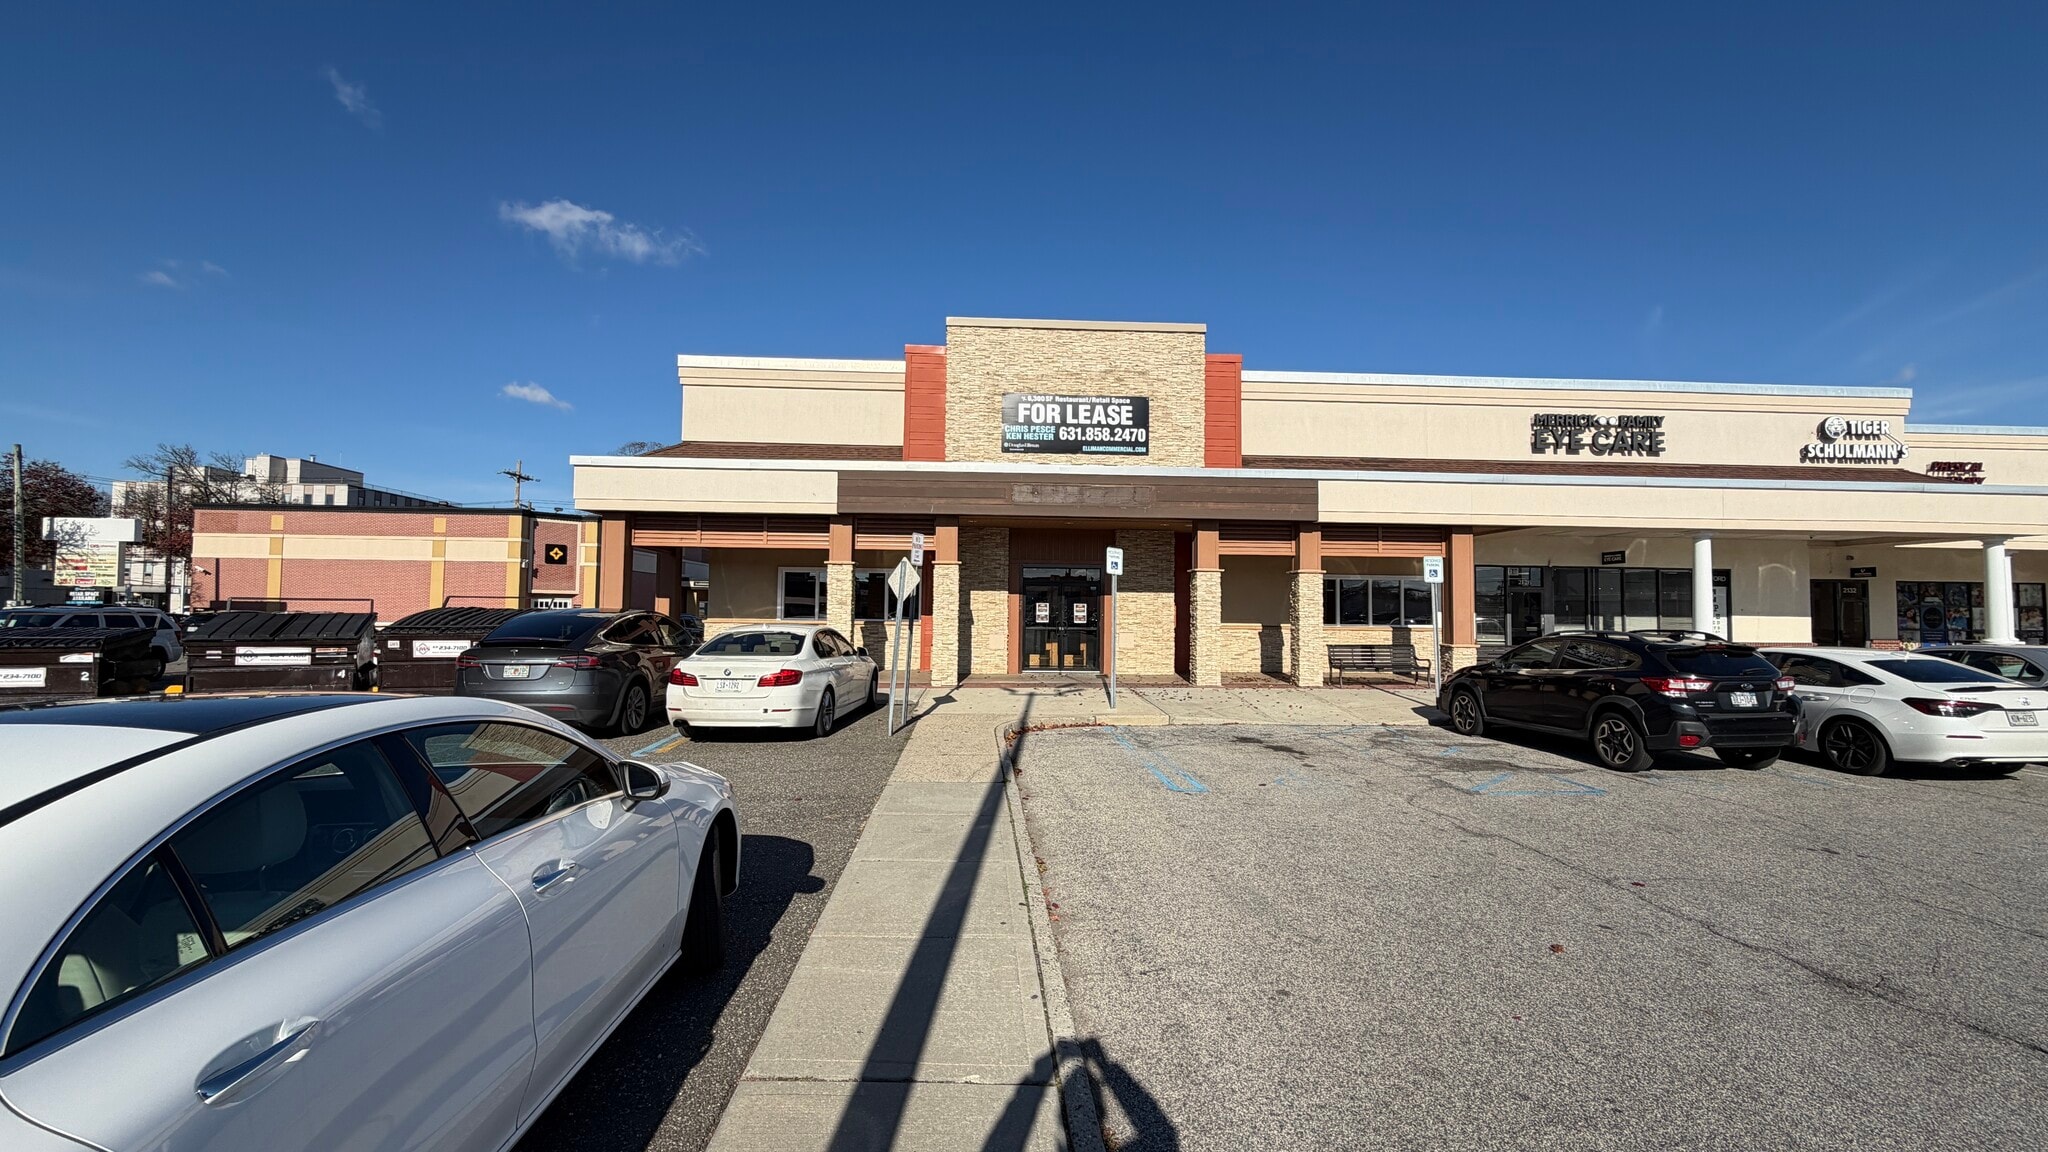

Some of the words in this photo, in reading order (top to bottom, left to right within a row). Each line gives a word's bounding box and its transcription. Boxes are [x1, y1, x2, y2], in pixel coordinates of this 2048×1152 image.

[1112, 397, 1130, 405] Space
[1018, 403, 1060, 423] FOR
[1066, 404, 1133, 425] LEASE
[1534, 414, 1597, 428] MERRICK
[1618, 415, 1665, 428] FAMILY
[1059, 426, 1146, 442] 631.858.2470
[1849, 420, 1890, 434] TIGER
[1534, 429, 1584, 450] EYE
[1591, 430, 1666, 452] CARE
[1808, 444, 1909, 459] SCHULMANN'S
[1930, 461, 1983, 472] PHYSICAL
[80, 672, 90, 681] 2
[337, 669, 346, 679] 4
